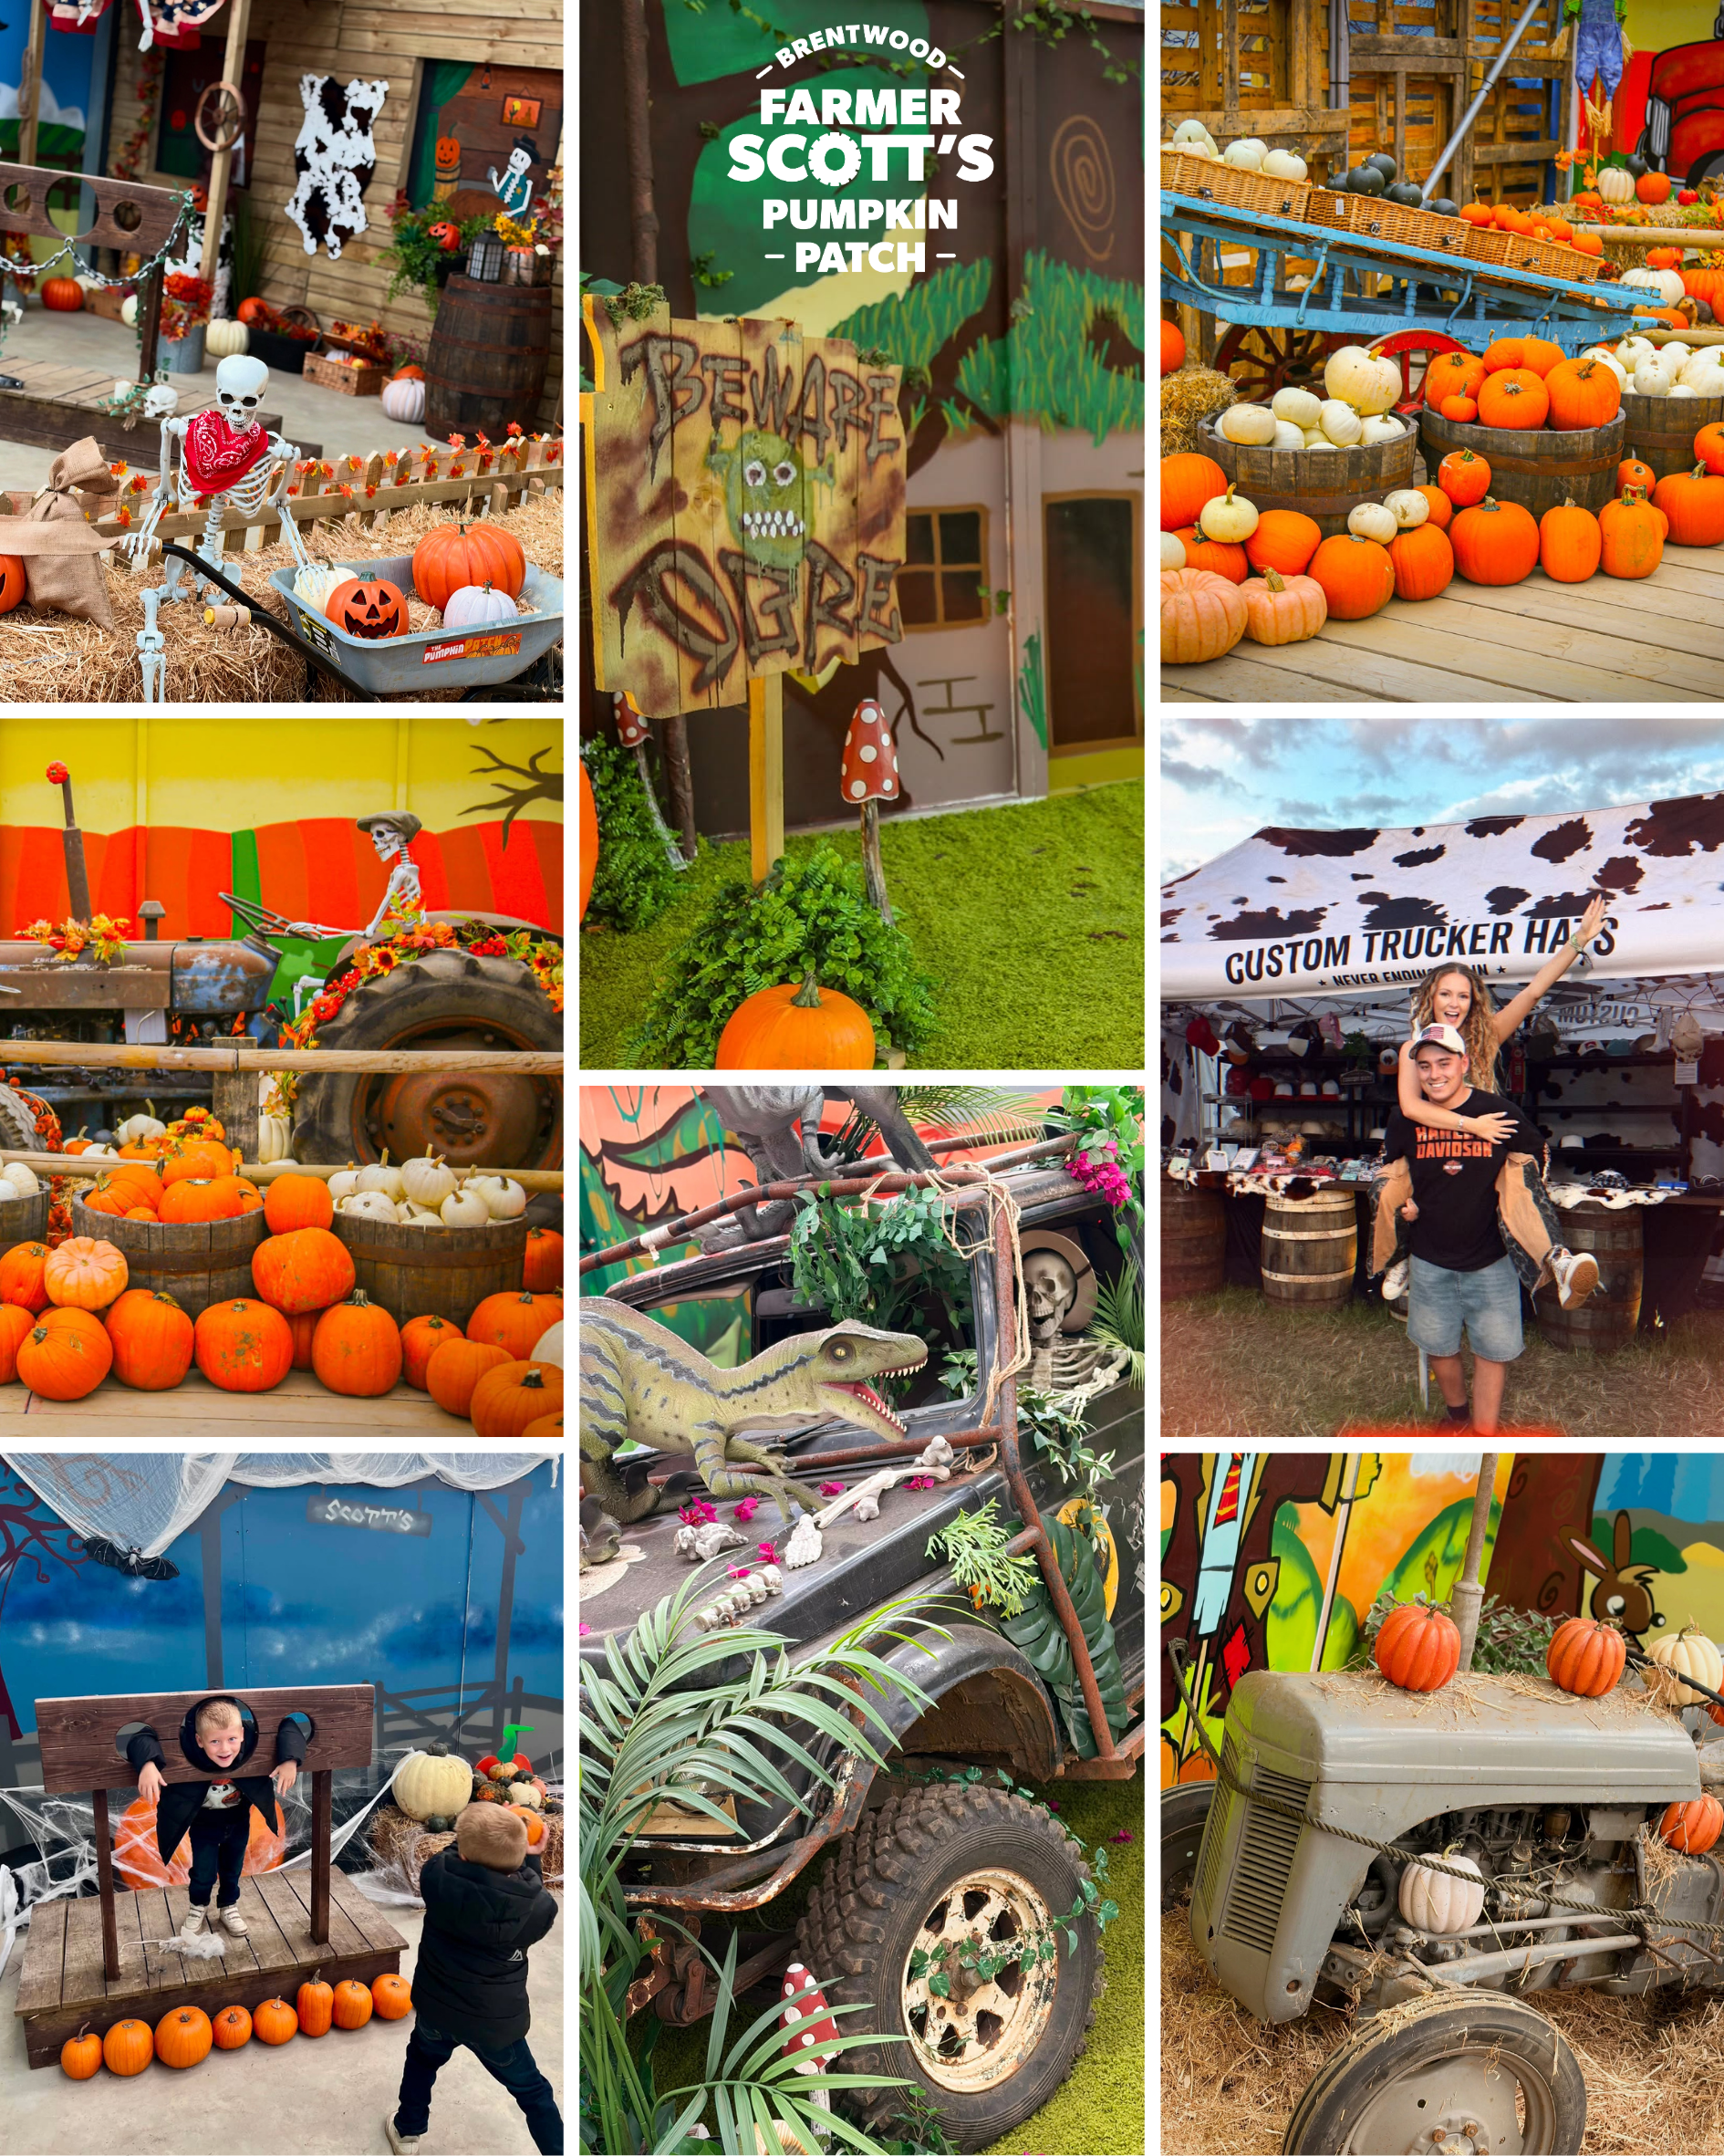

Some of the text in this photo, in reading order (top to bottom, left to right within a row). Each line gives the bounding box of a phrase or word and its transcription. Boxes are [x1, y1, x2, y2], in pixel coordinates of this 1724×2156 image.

[620, 334, 900, 465] BEWARE
[610, 541, 903, 693] OGRE
[423, 635, 503, 662] PUMPKIN PATCH
[1225, 917, 1619, 984] CUSTOM TRUCKER HAS
[1333, 973, 1380, 986] NEVER
[1416, 1140, 1492, 1159] DAVIDSON
[325, 1498, 414, 1531] SCOTT'S
